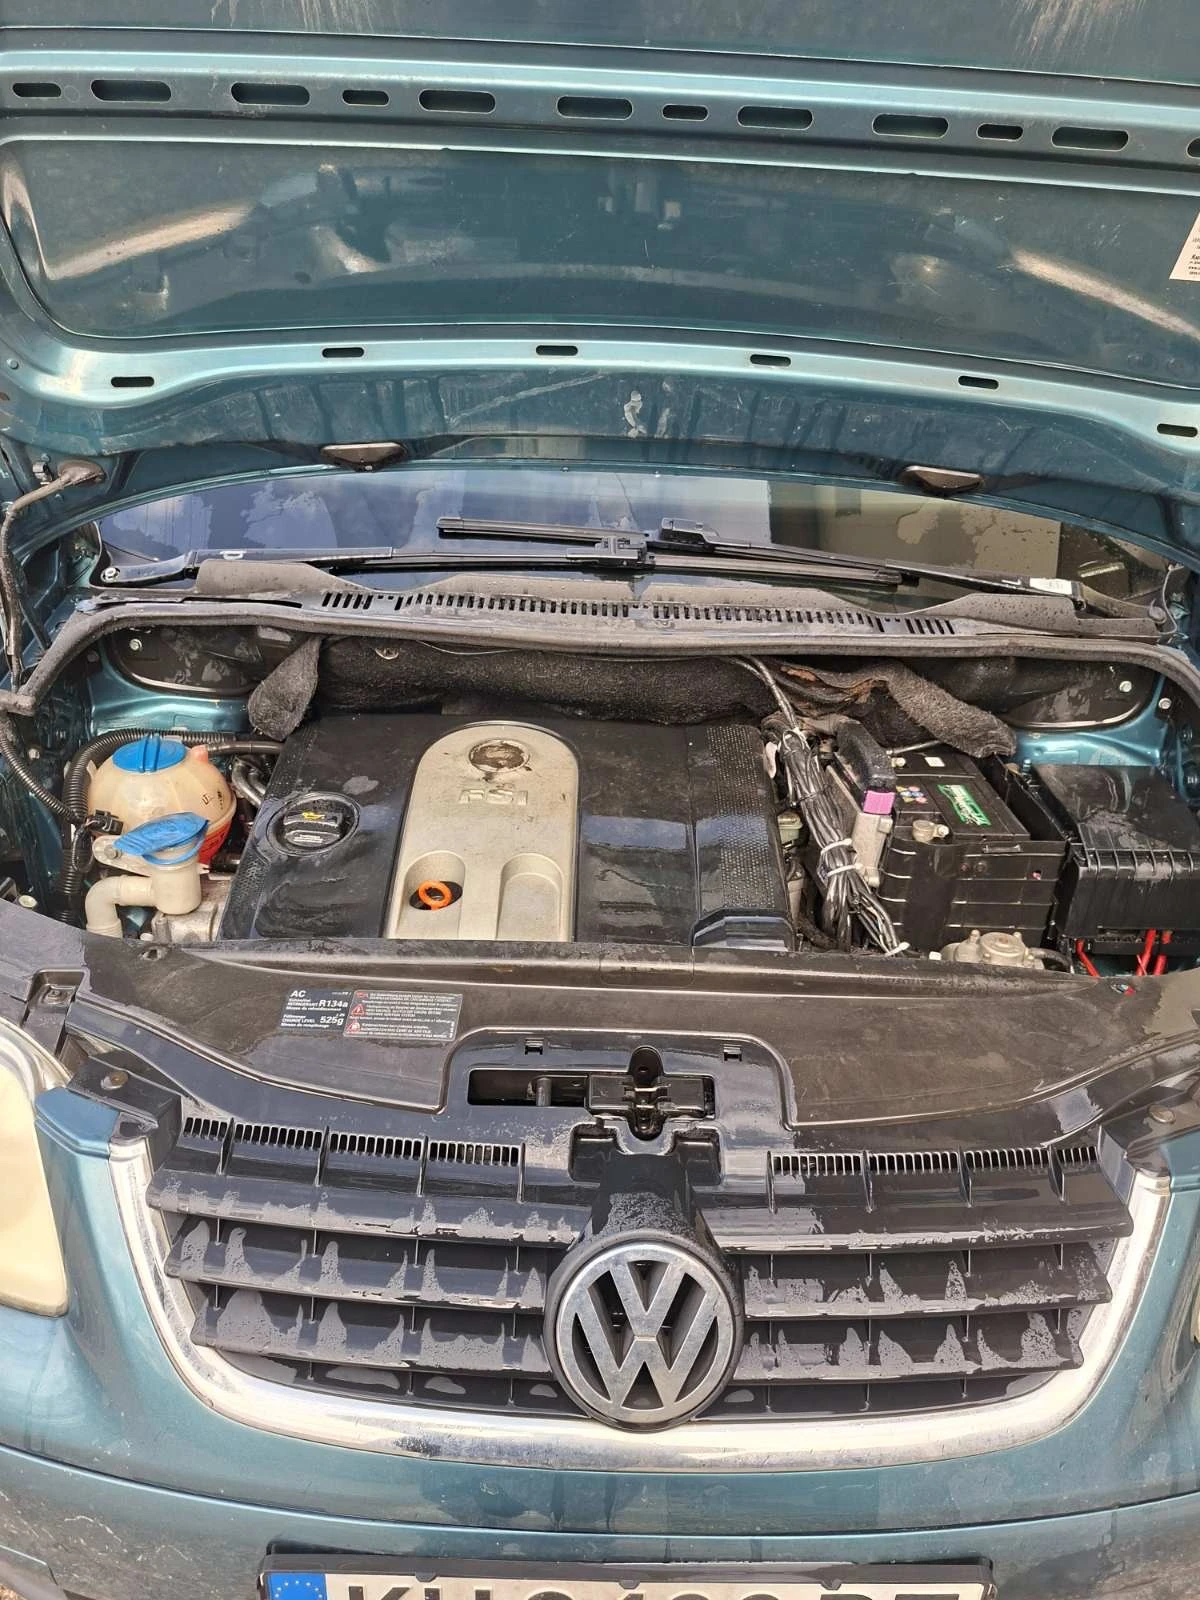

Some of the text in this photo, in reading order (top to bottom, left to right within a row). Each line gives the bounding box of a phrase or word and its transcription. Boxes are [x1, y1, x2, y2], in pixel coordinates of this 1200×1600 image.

[459, 789, 528, 806] FSI
[290, 990, 306, 998] AC
[319, 999, 349, 1008] R134a
[320, 1015, 344, 1026] 525g
[563, 1246, 729, 1418] VW
